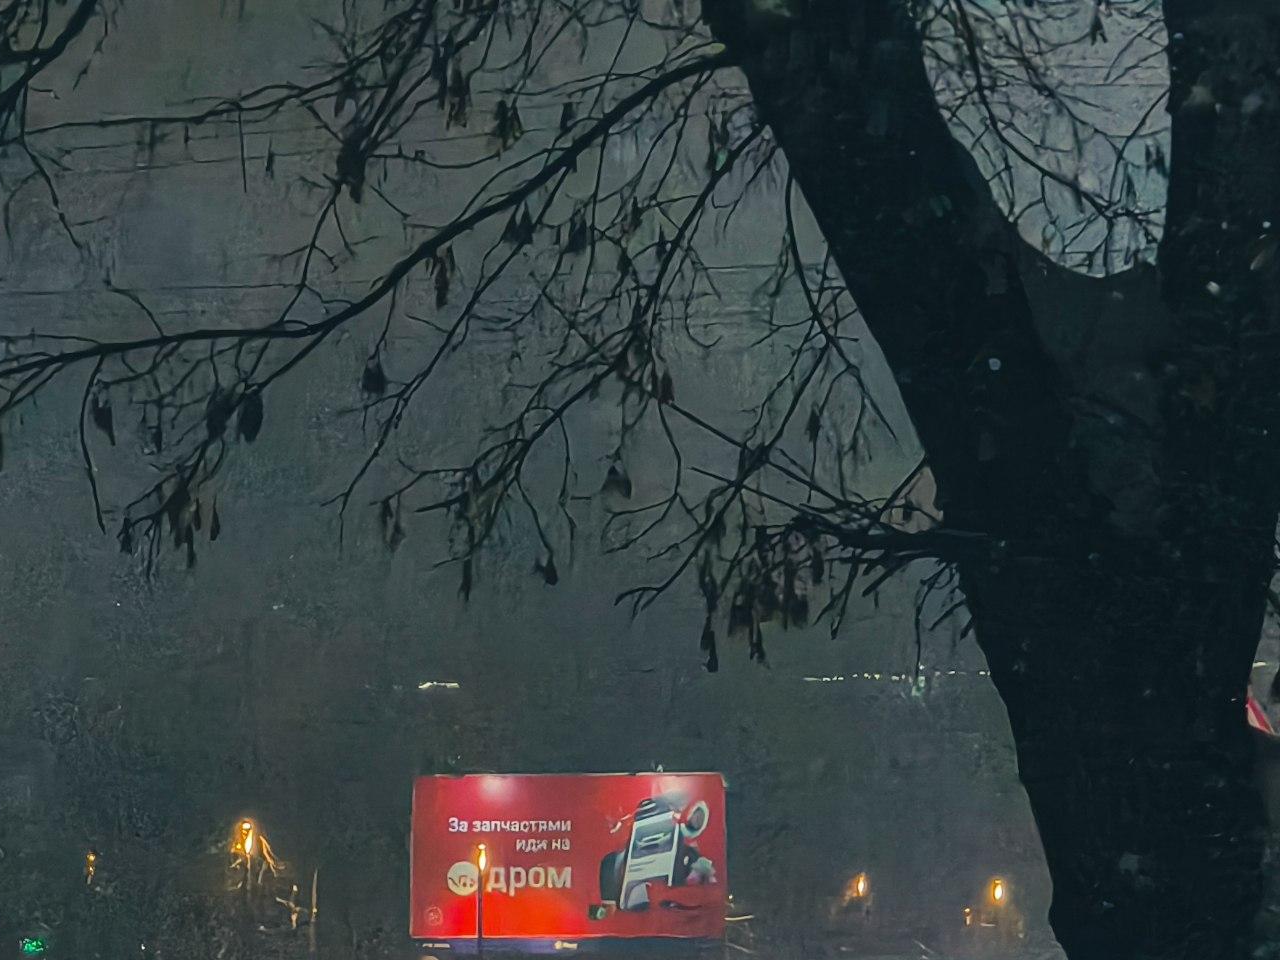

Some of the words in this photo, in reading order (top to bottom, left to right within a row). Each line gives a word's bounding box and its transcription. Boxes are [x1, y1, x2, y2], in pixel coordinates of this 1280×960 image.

[448, 817, 468, 832] За
[472, 819, 571, 832] запчастями
[516, 839, 547, 852] иди
[552, 838, 571, 850] на
